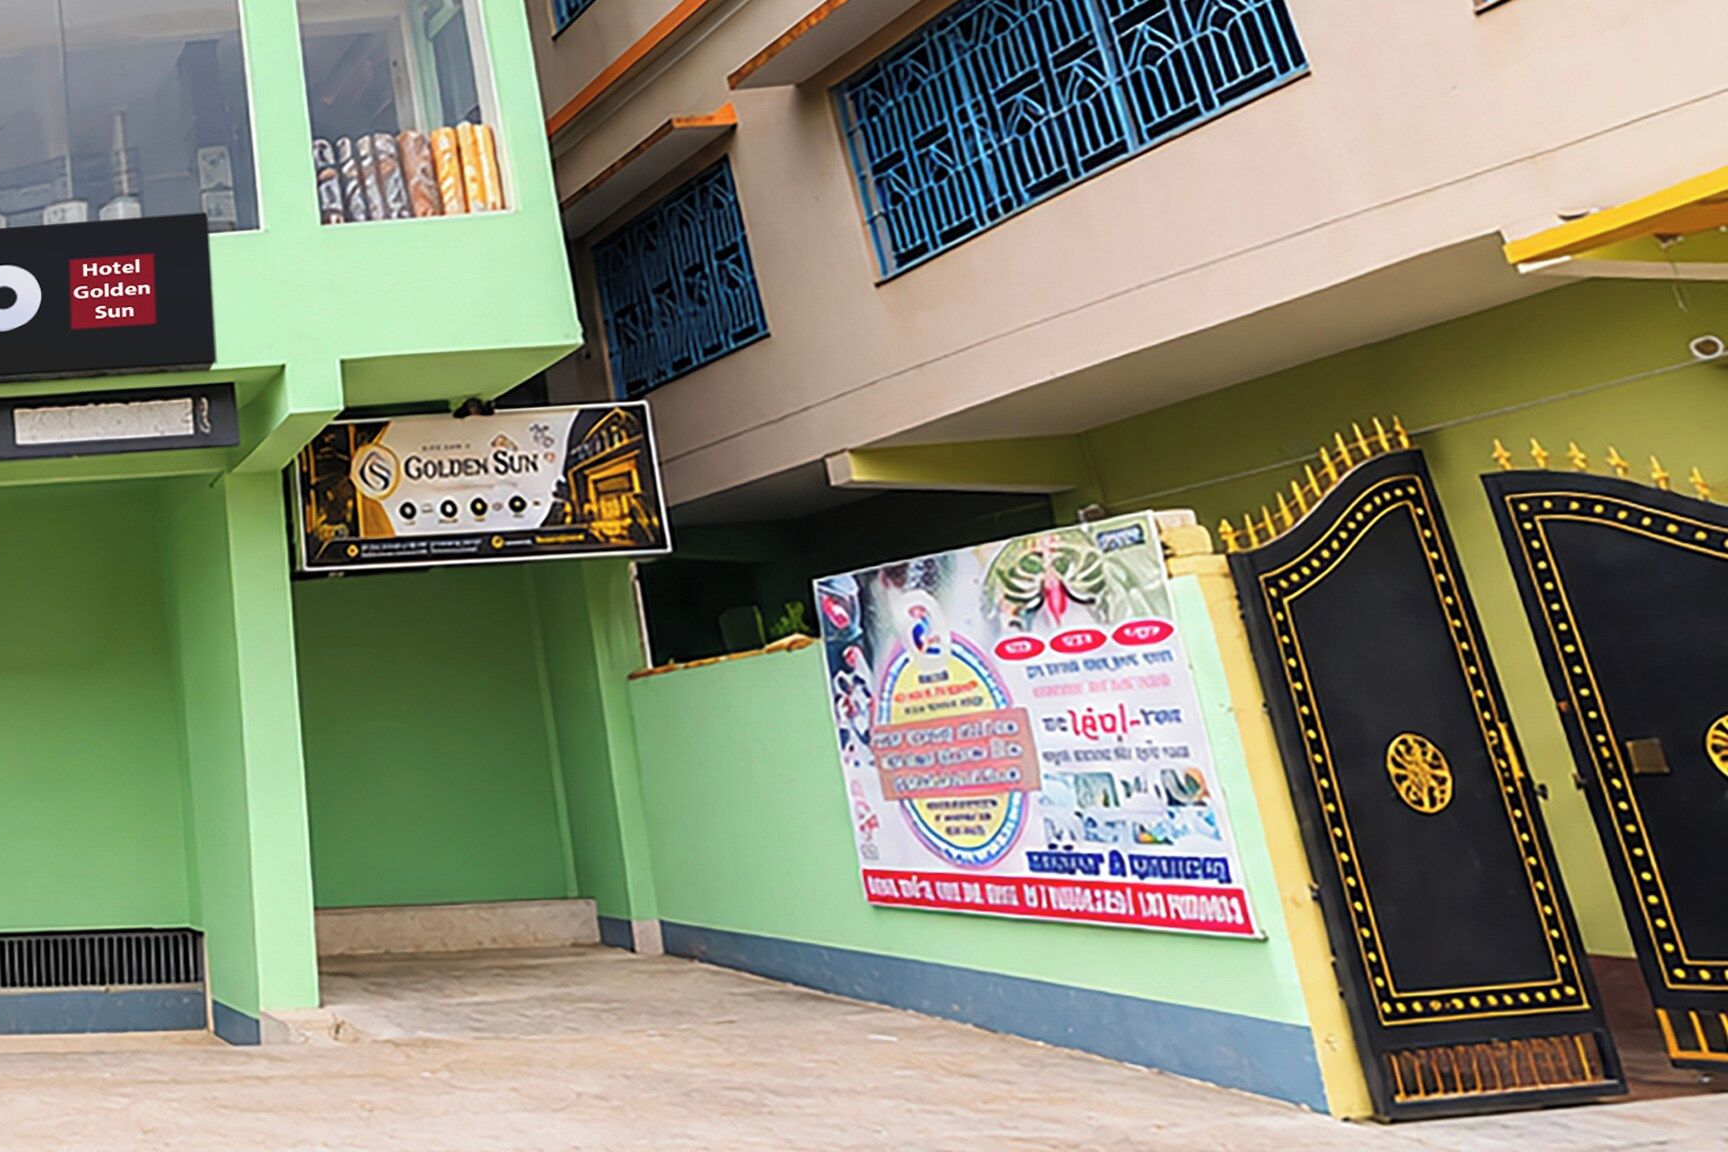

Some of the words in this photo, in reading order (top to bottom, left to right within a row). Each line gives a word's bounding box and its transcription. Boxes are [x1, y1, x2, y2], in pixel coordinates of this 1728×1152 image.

[81, 258, 141, 277] Hotel
[73, 280, 151, 300] Golden
[94, 303, 135, 320] Sun
